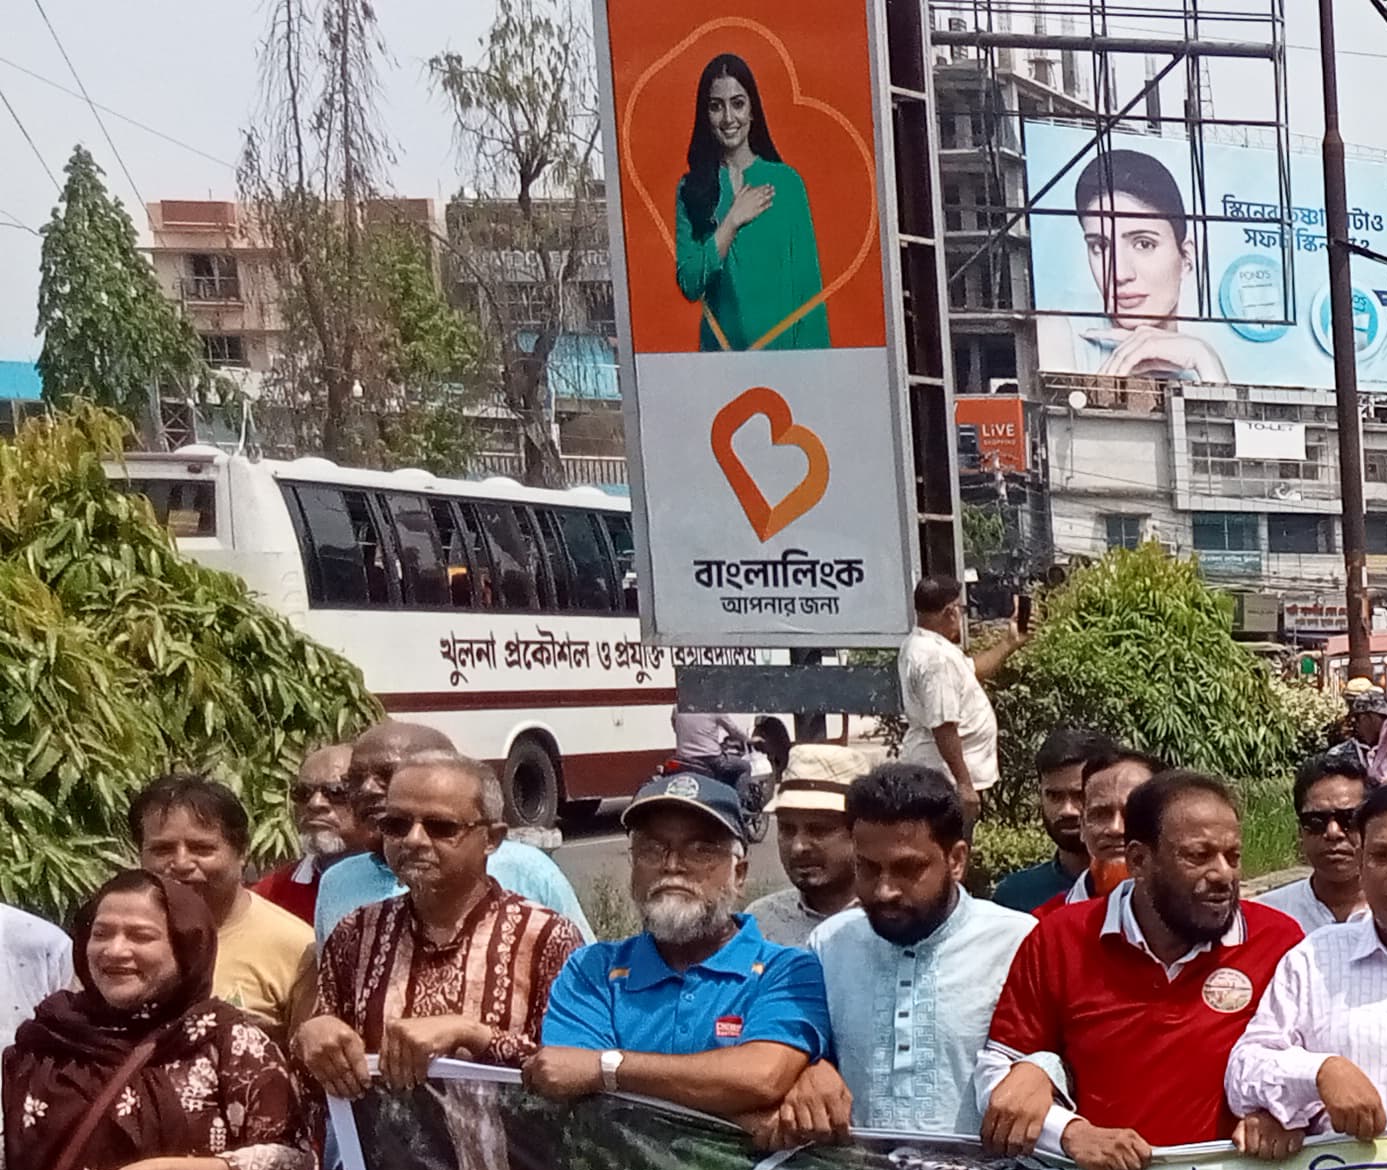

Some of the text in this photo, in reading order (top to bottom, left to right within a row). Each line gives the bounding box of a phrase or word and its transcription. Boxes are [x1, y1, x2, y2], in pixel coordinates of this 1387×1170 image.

[981, 423, 1016, 437] LiVE
[694, 548, 864, 590] বাংলালিংক
[721, 595, 840, 616] আপনার জন্য
[439, 629, 496, 685] খুলনা
[504, 623, 590, 672] প্রকৌশল
[597, 640, 612, 671] ও
